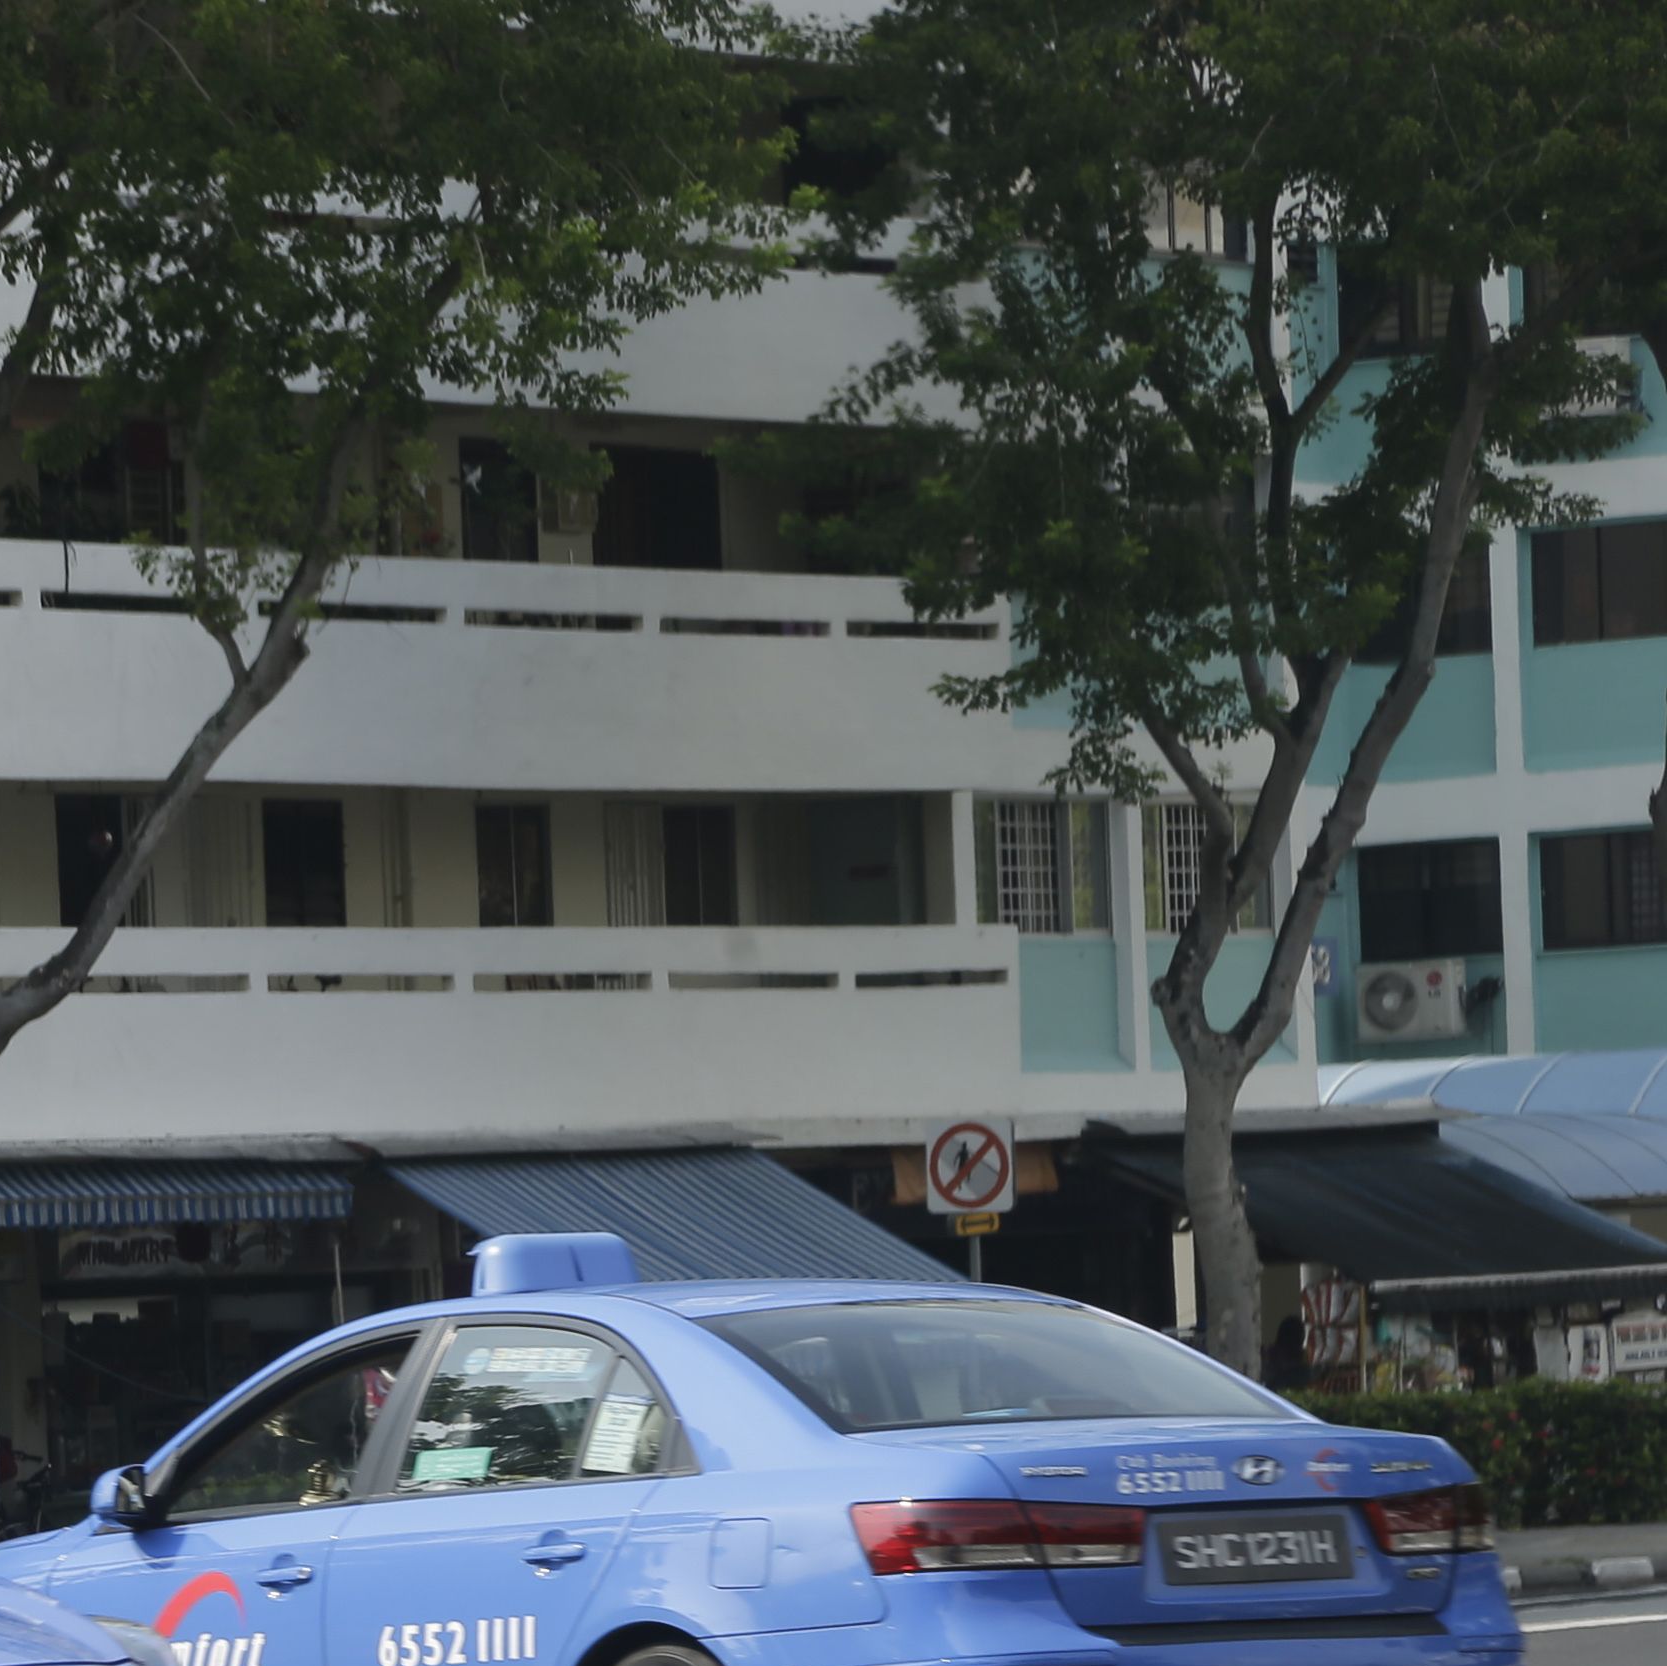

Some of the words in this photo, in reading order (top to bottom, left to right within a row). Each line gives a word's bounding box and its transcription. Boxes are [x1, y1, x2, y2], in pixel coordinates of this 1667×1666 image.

[1117, 1472, 1184, 1495] 6552
[1172, 1529, 1339, 1569] SHC1231H
[476, 1615, 536, 1662] 1111
